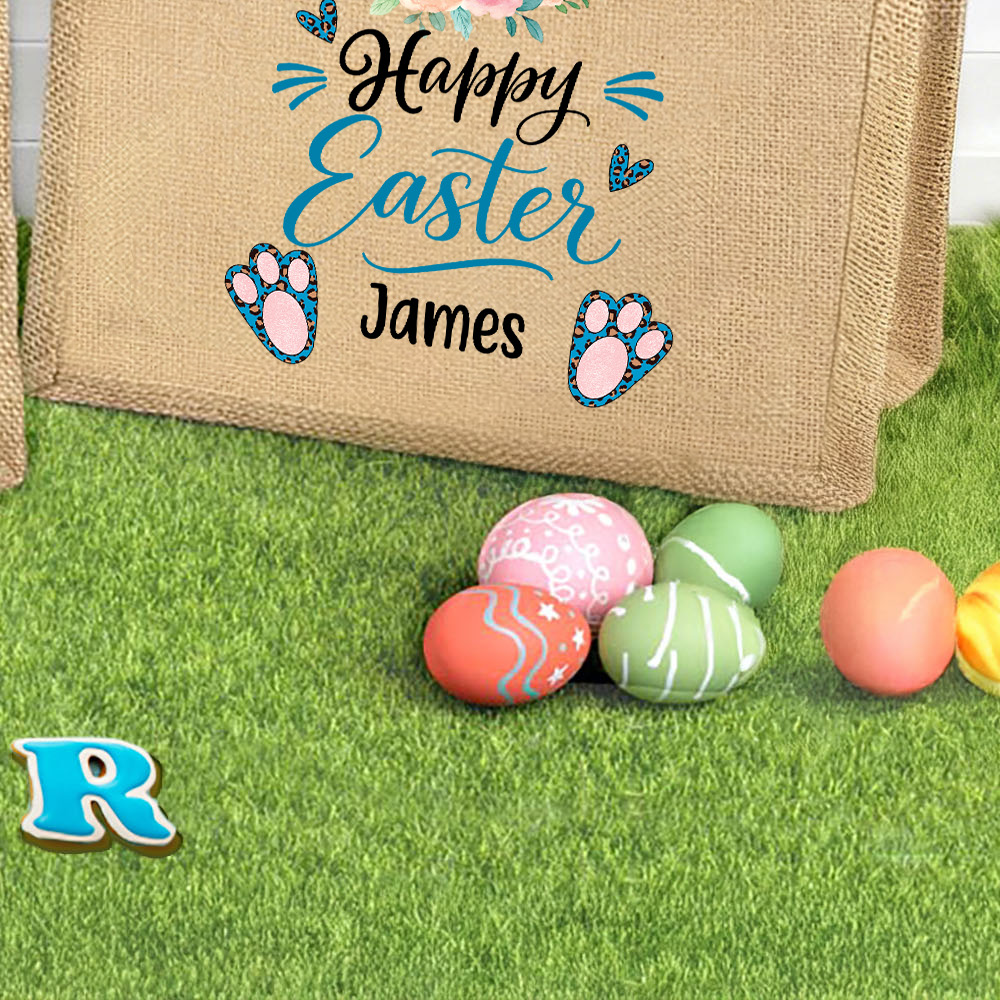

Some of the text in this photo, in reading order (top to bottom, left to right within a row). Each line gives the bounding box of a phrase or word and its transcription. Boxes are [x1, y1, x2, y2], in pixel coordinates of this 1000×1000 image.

[339, 28, 590, 145] Happy
[282, 113, 622, 265] Easter
[360, 282, 525, 359] James
